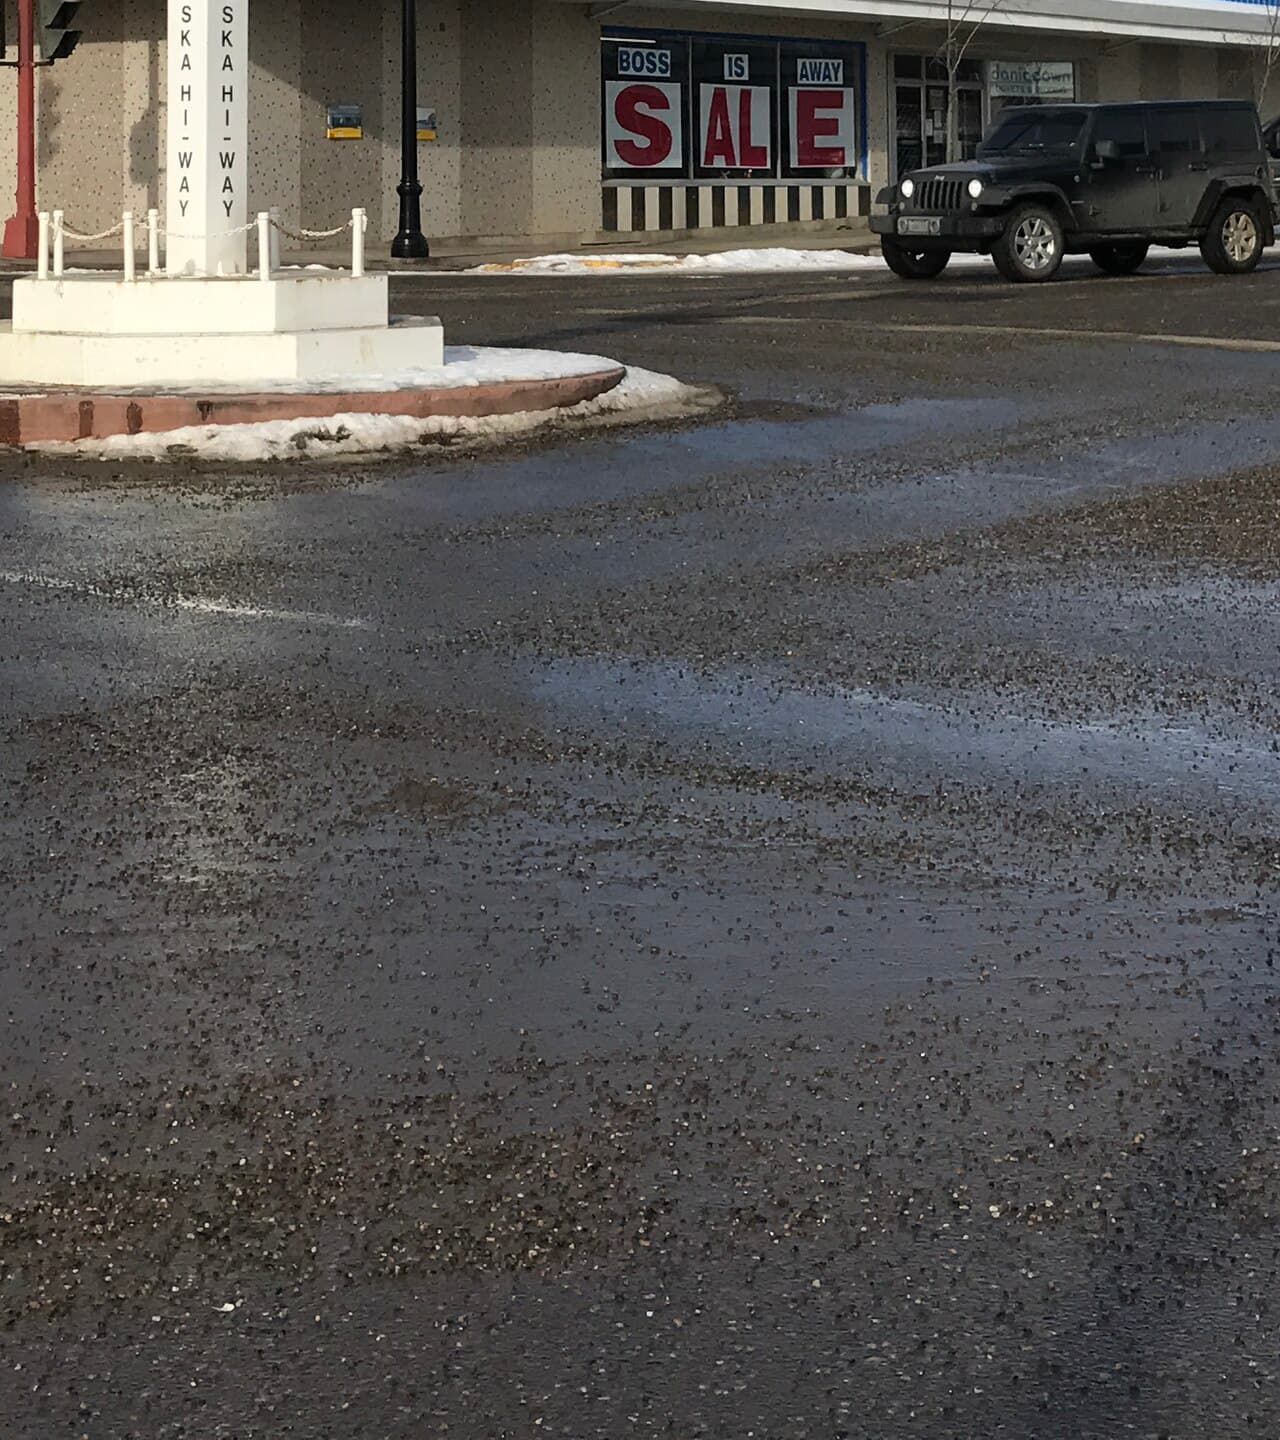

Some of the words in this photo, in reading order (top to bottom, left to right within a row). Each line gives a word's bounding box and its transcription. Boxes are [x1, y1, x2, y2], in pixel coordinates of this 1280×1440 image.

[619, 50, 670, 74] BOSS
[727, 57, 745, 78] IS
[799, 62, 842, 82] AWAY
[178, 85, 192, 217] HI-WAY
[219, 85, 235, 218] HI-WAY
[614, 84, 846, 166] SALE
